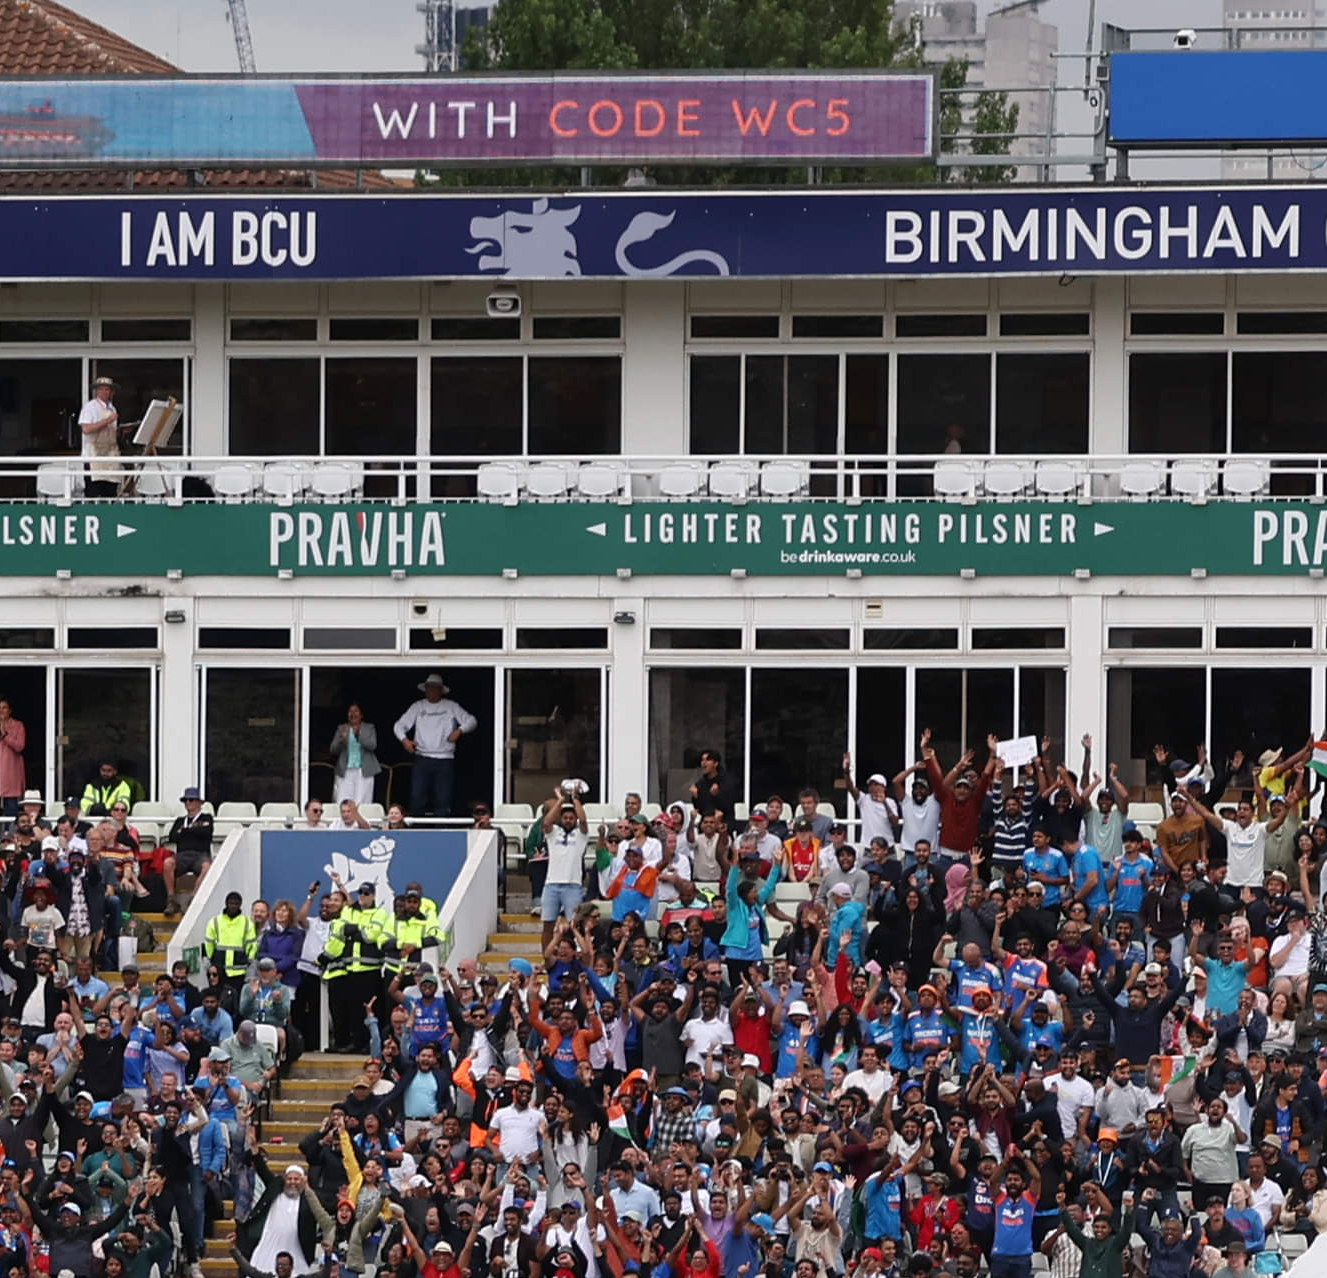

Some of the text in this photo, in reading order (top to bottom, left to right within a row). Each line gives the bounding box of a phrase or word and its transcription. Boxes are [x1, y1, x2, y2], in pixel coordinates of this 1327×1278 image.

[372, 98, 850, 139] WITH CODE WC5
[121, 211, 316, 267] I AM BCU
[885, 204, 1300, 263] BIRMINGHAM
[270, 511, 446, 566] PRAVHA
[624, 513, 1076, 544] LIGHTER TASTING PILSNER
[780, 549, 916, 563] bedrinkaware.co.uk
